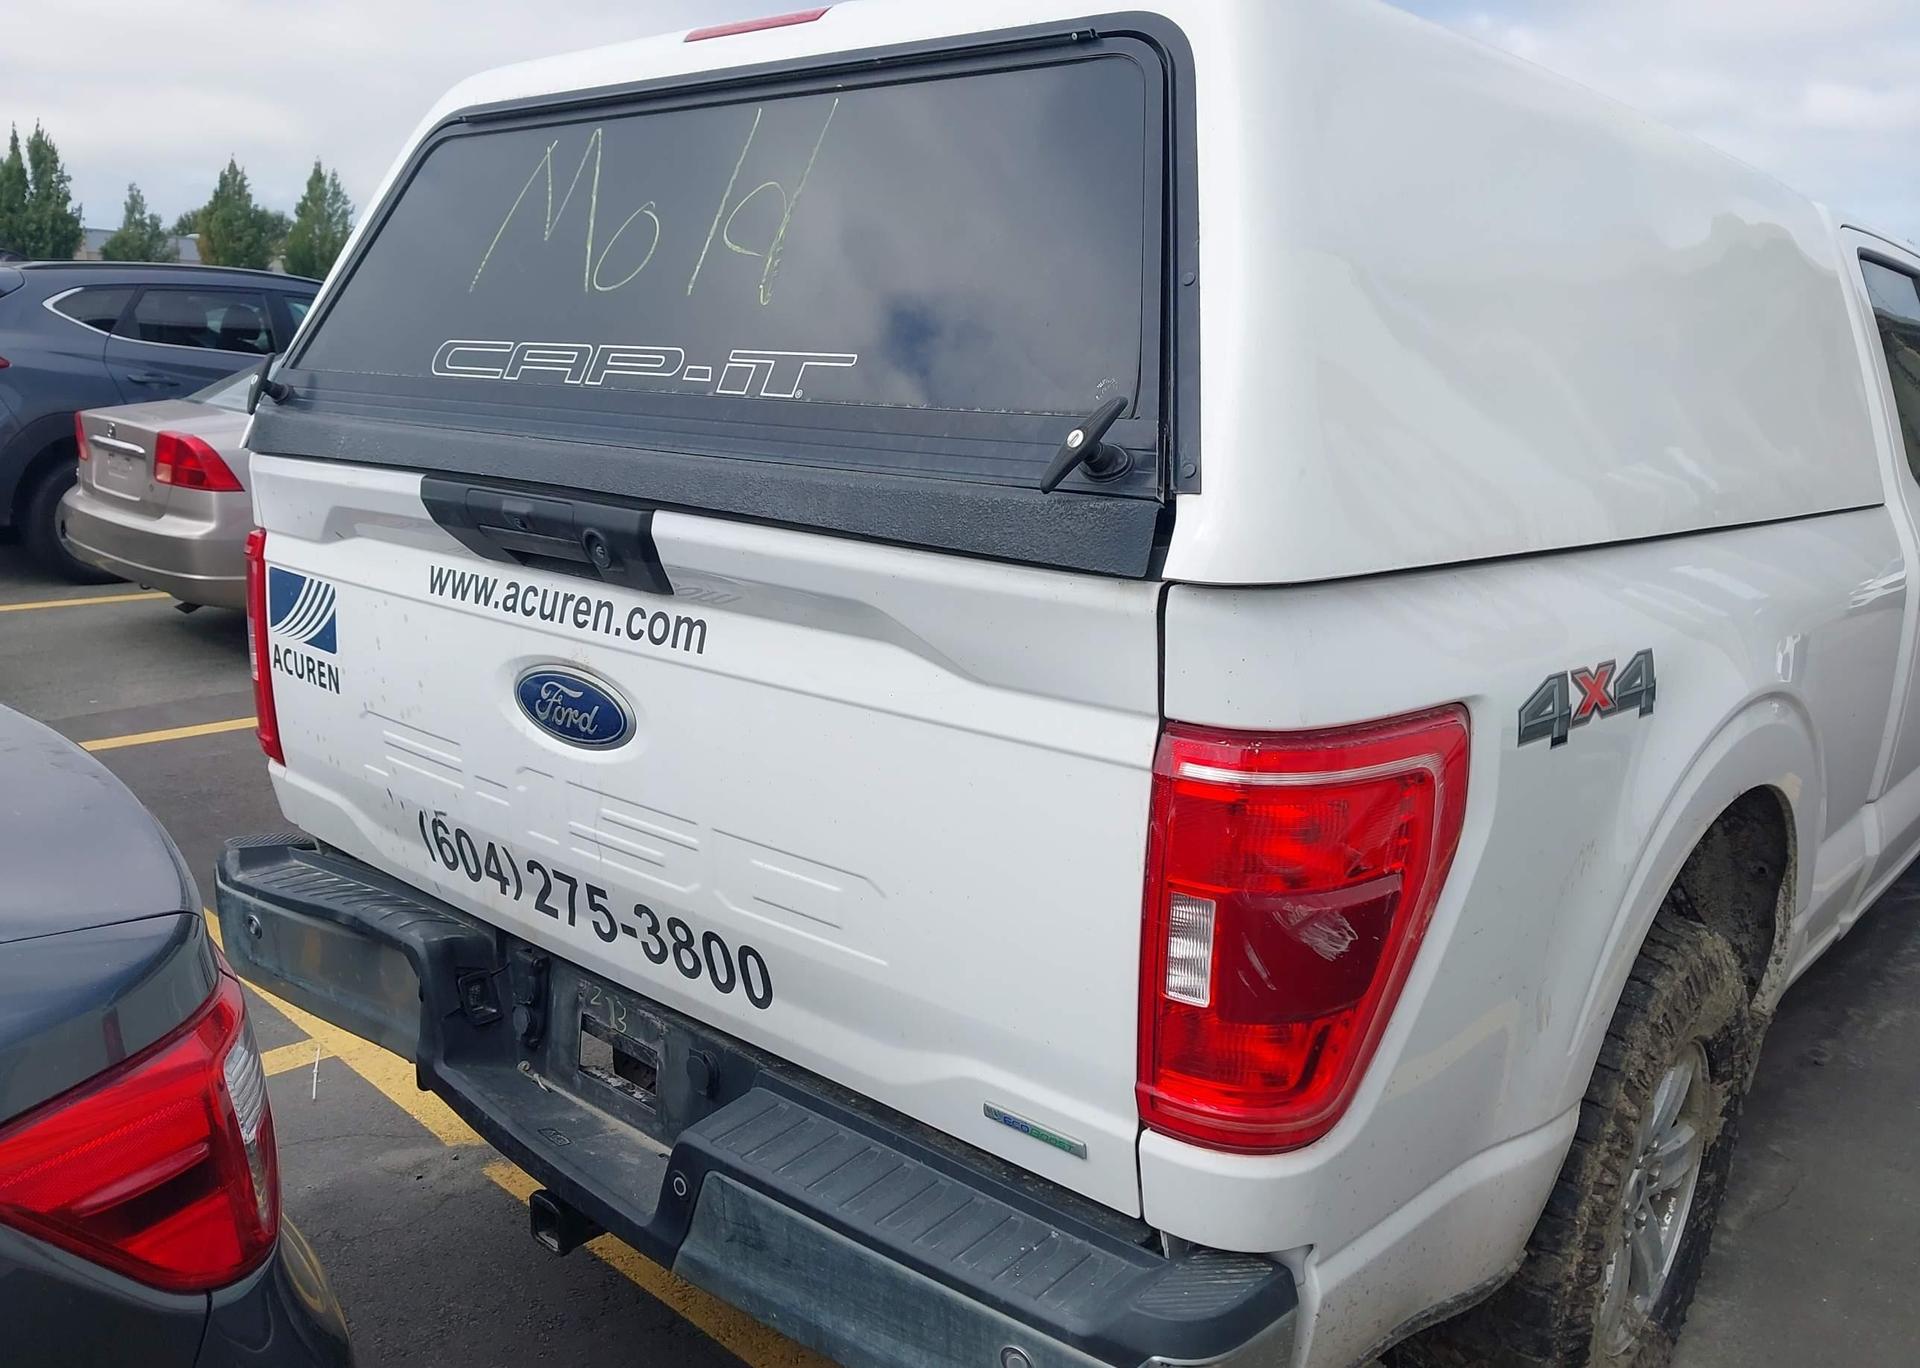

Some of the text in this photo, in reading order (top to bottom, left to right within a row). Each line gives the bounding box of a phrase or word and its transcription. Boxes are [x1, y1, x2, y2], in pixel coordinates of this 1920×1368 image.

[428, 564, 709, 655] www.acuren.com
[272, 643, 341, 695] ACUREN
[534, 680, 599, 737] Ford
